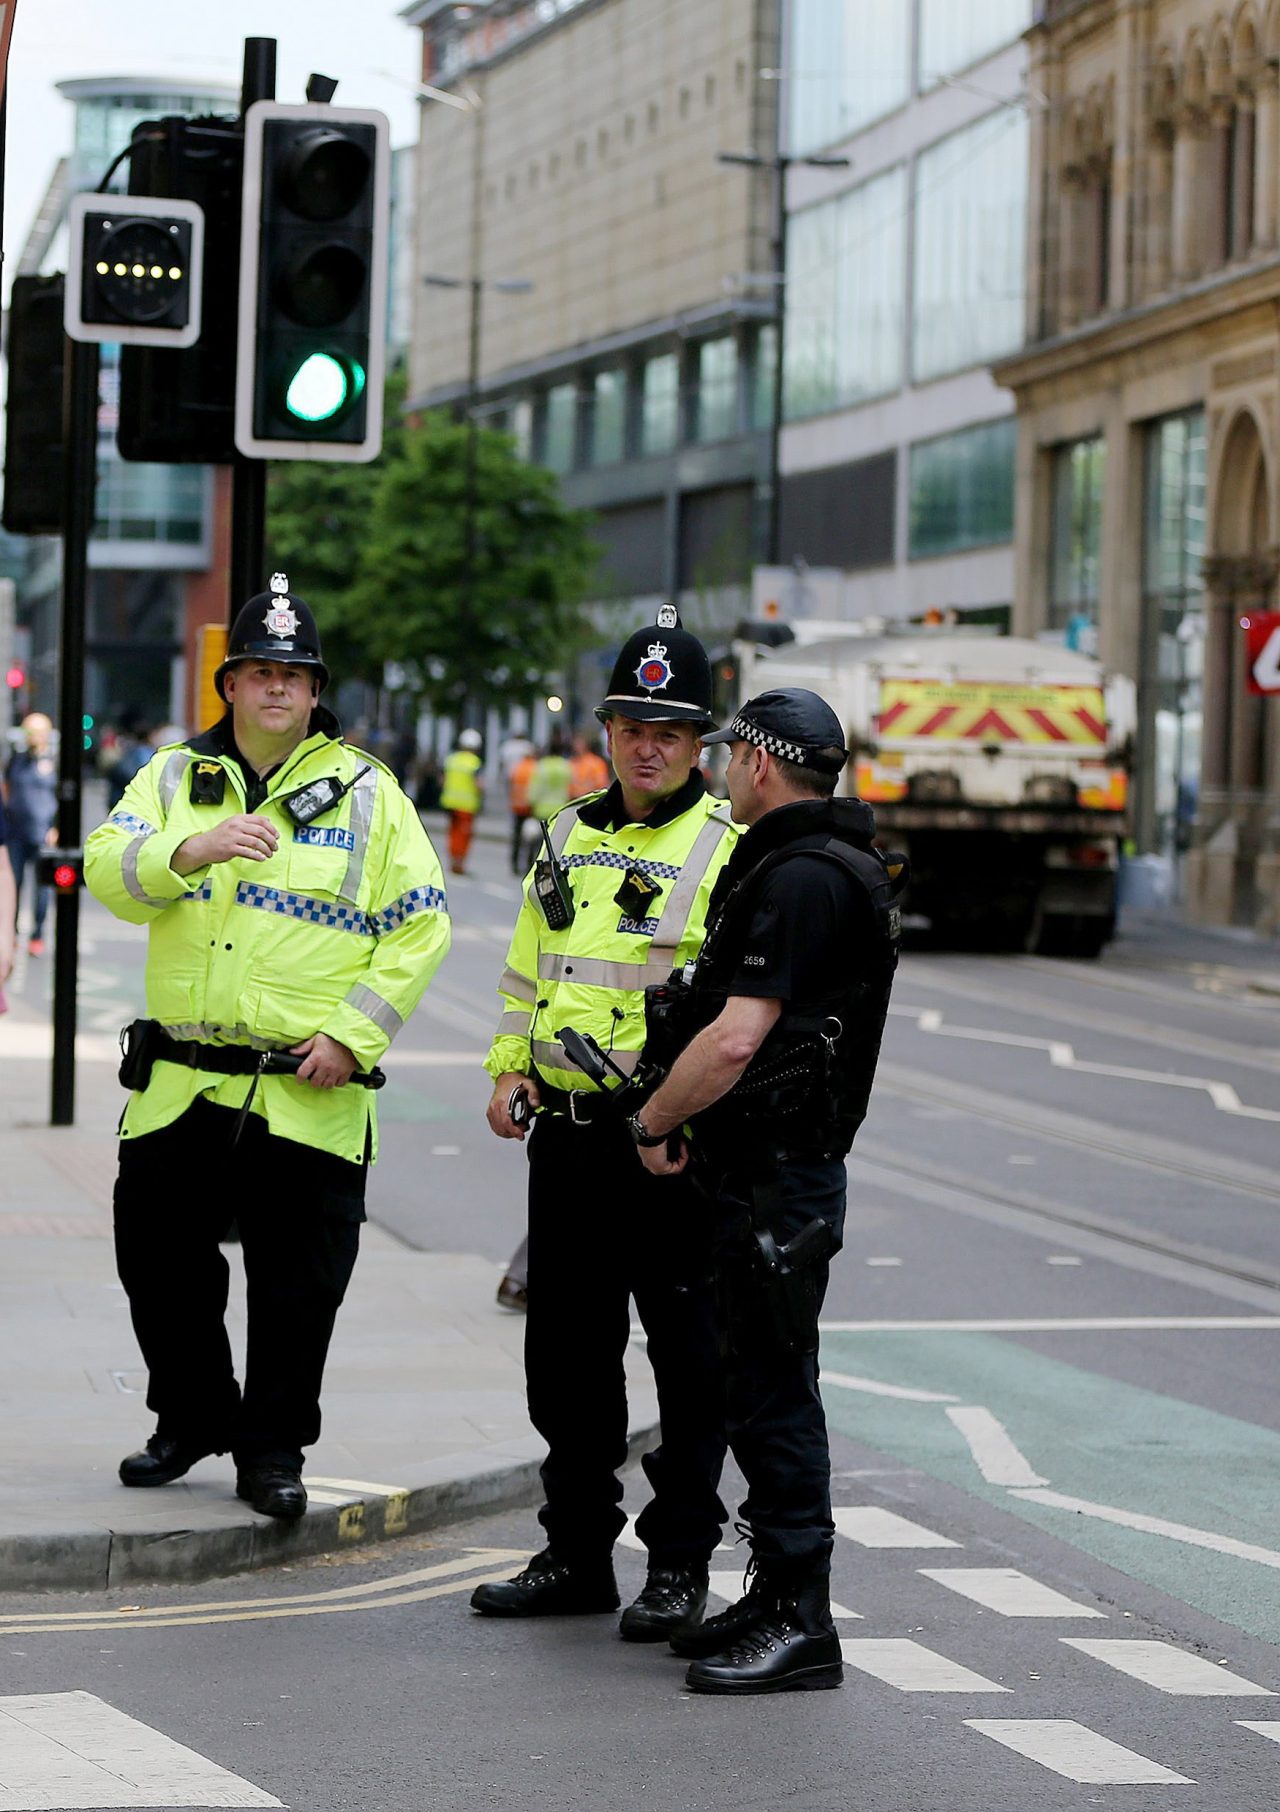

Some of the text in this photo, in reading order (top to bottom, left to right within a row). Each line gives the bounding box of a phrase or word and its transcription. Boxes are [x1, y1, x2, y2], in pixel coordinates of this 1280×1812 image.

[296, 827, 353, 849] POLICE
[618, 916, 658, 934] POLCE
[743, 955, 765, 966] 2659
